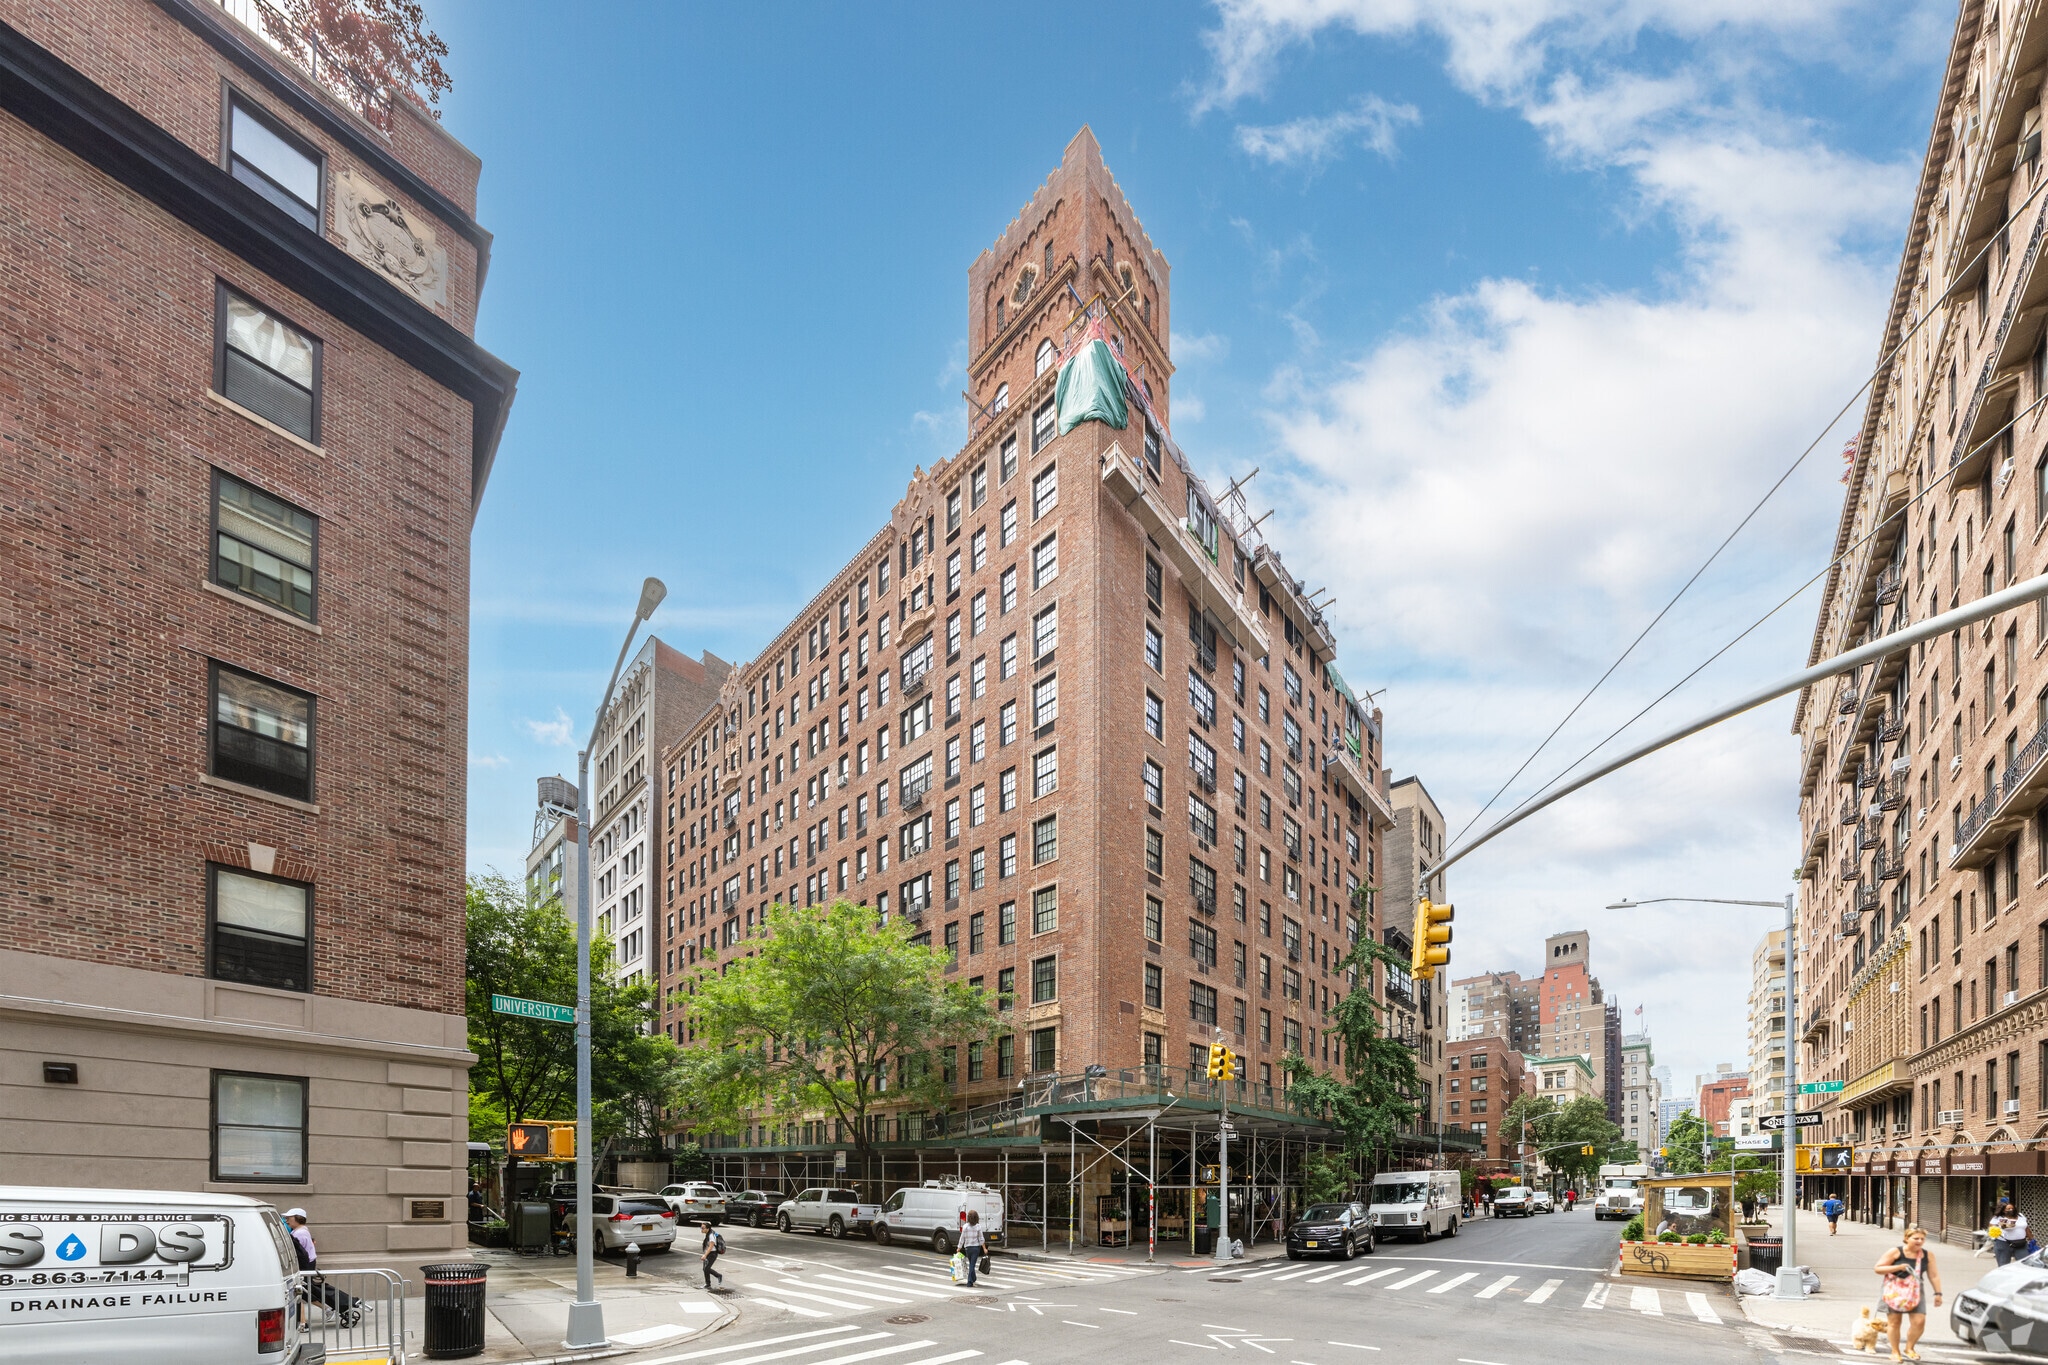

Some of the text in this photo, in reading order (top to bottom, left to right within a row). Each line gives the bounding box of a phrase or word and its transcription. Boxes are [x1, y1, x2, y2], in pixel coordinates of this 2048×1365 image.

[495, 997, 572, 1019] UNIVERSITY PL
[1801, 1085, 1808, 1093] E
[1814, 1083, 1827, 1092] 10
[99, 1223, 206, 1266] DS
[11, 1291, 228, 1312] DRAINAGE FAILURE
